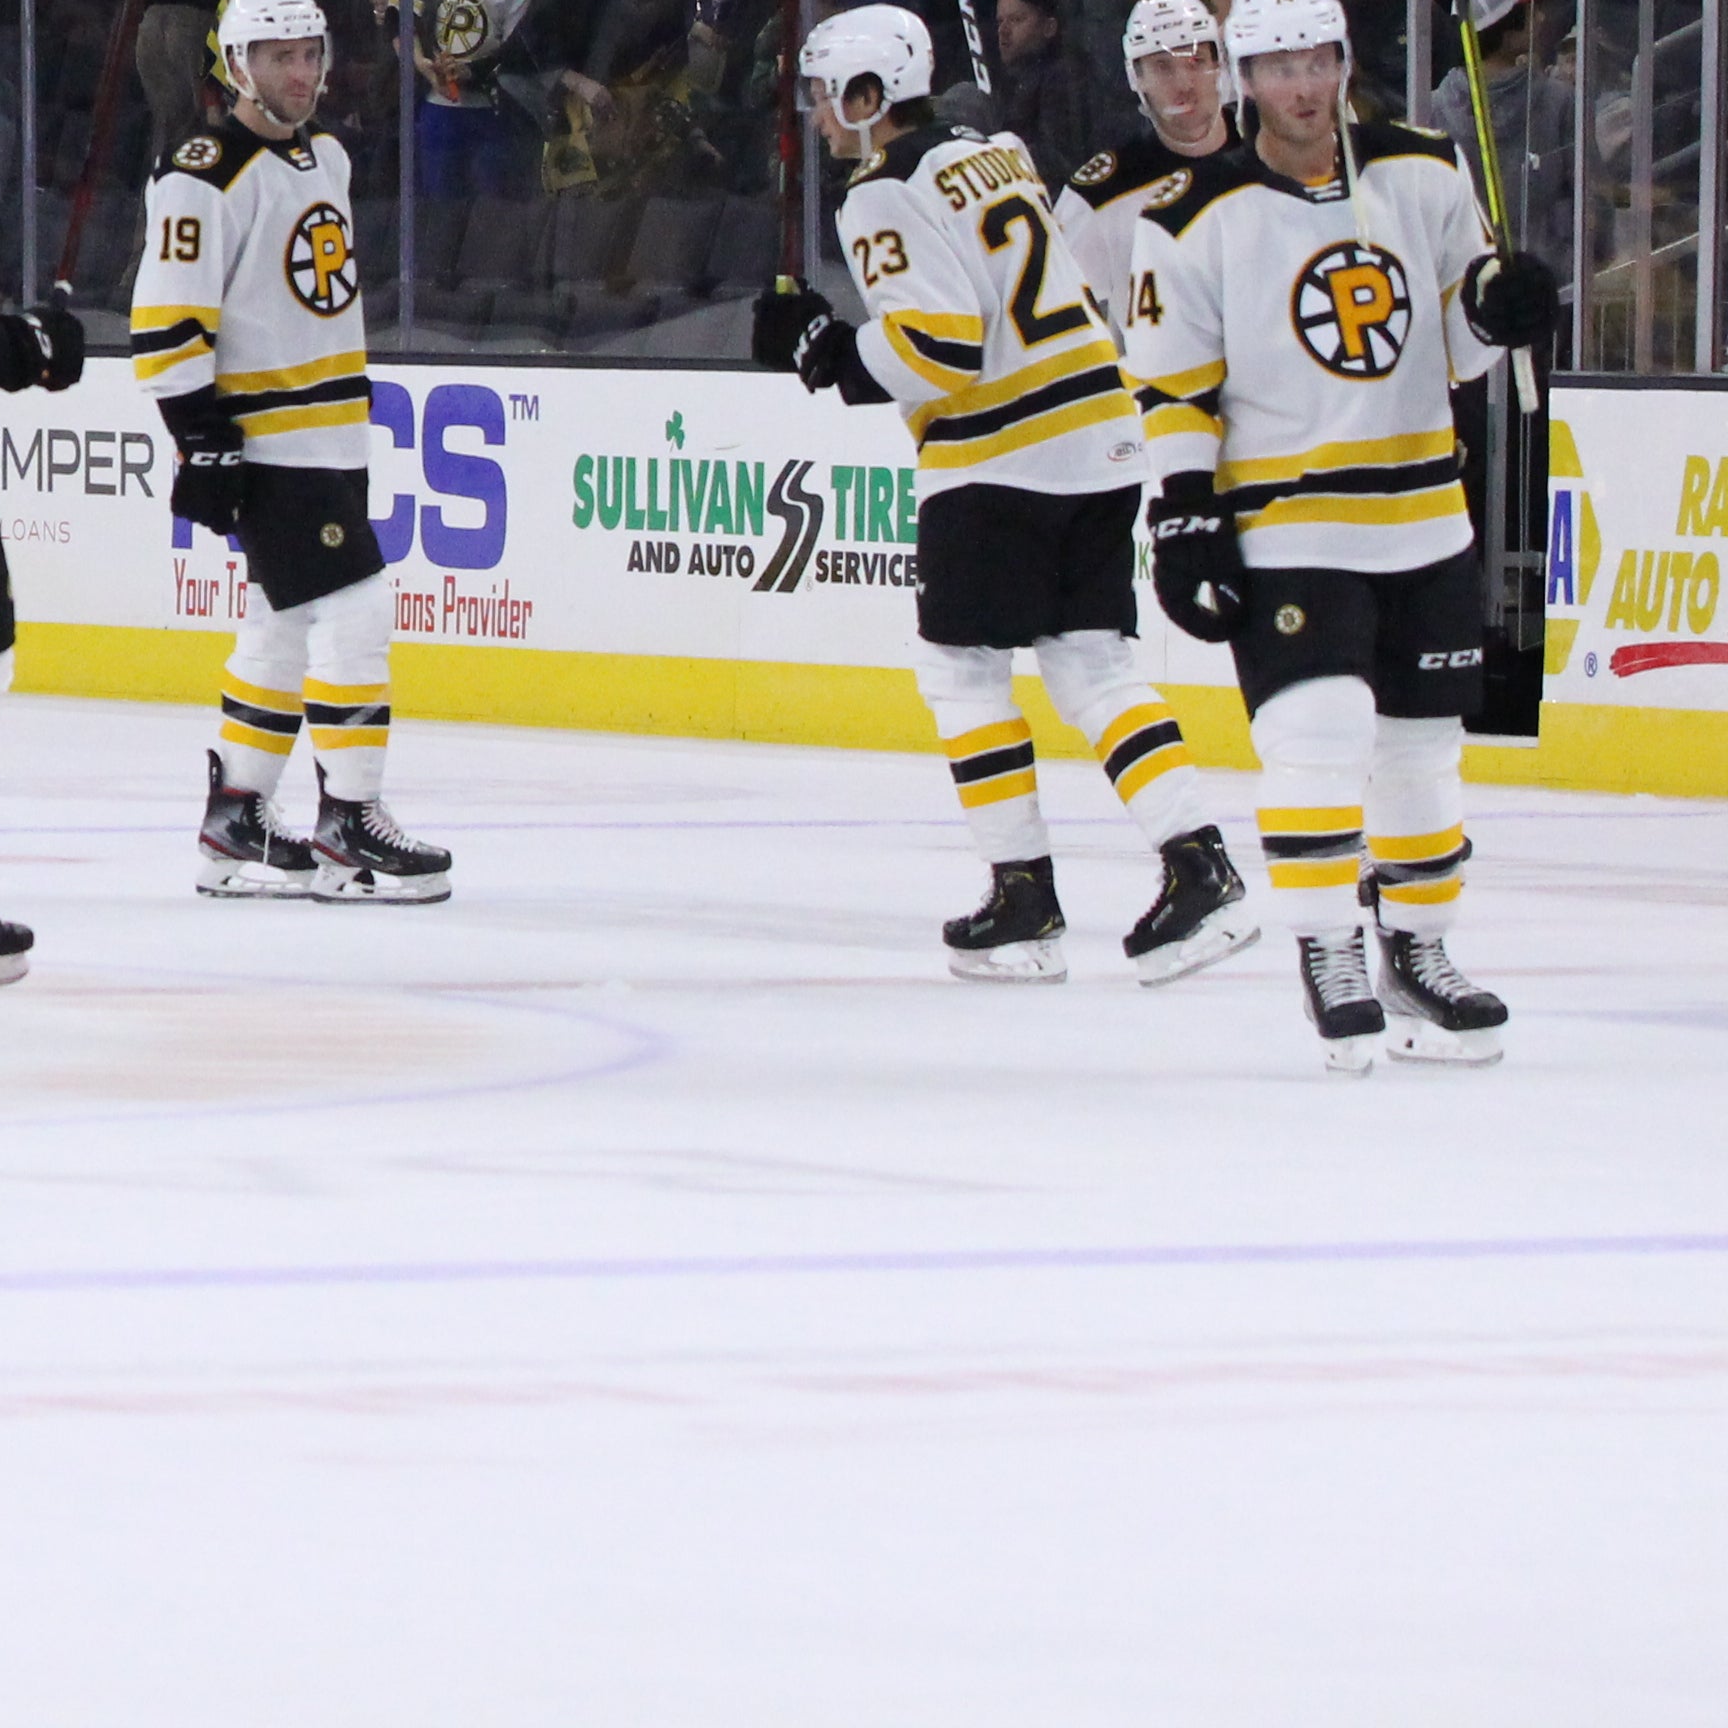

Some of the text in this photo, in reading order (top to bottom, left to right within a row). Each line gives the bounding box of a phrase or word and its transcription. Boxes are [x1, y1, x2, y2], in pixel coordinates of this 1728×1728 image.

[158, 215, 202, 264] 19
[310, 216, 349, 299] P
[851, 228, 910, 288] 23
[1328, 263, 1396, 357] P
[572, 453, 917, 543] SULLIVAN TIRE
[1151, 517, 1222, 539] CM
[173, 557, 219, 617] Your
[443, 575, 533, 641] Provider
[627, 540, 917, 587] AND AUTO SERVICE
[1604, 549, 1720, 635] AUTO
